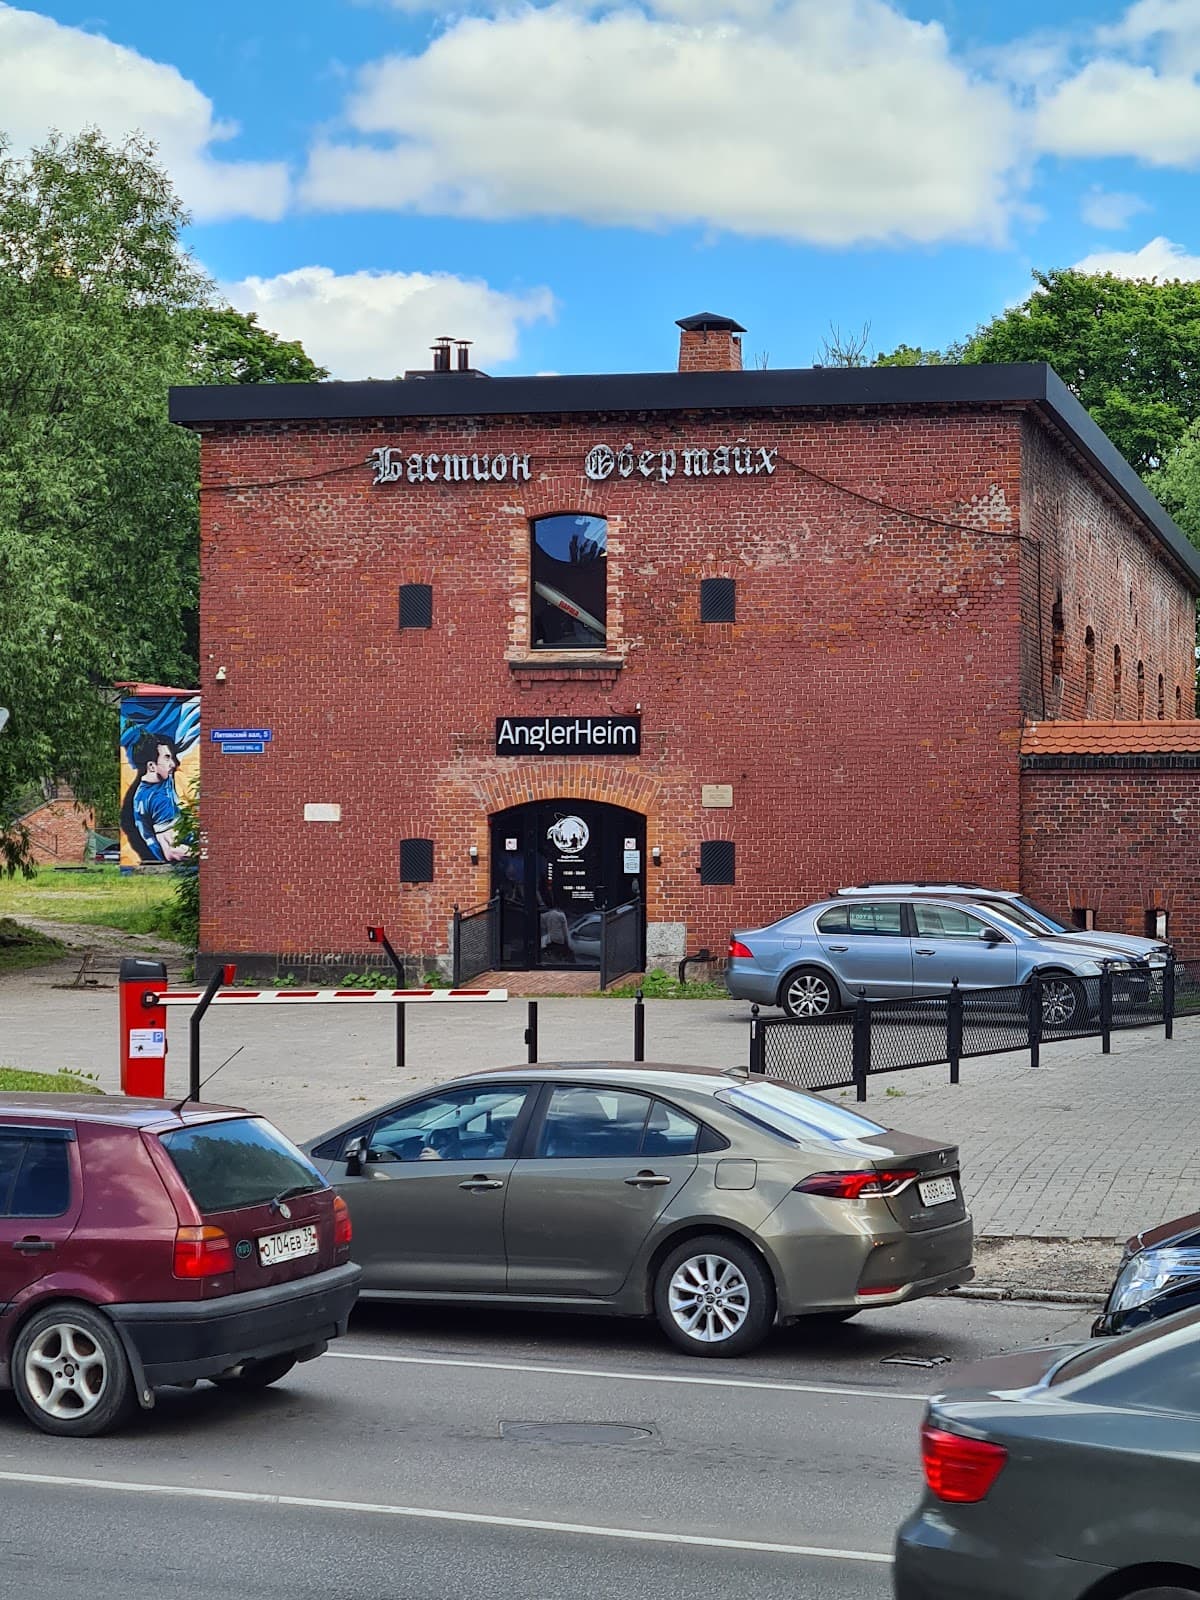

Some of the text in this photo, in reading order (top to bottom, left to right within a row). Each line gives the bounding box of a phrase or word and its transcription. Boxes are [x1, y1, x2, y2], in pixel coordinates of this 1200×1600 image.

[367, 438, 778, 485] Бастион Обертайх
[498, 718, 636, 751] AnglerHeim
[302, 1227, 312, 1242] 39
